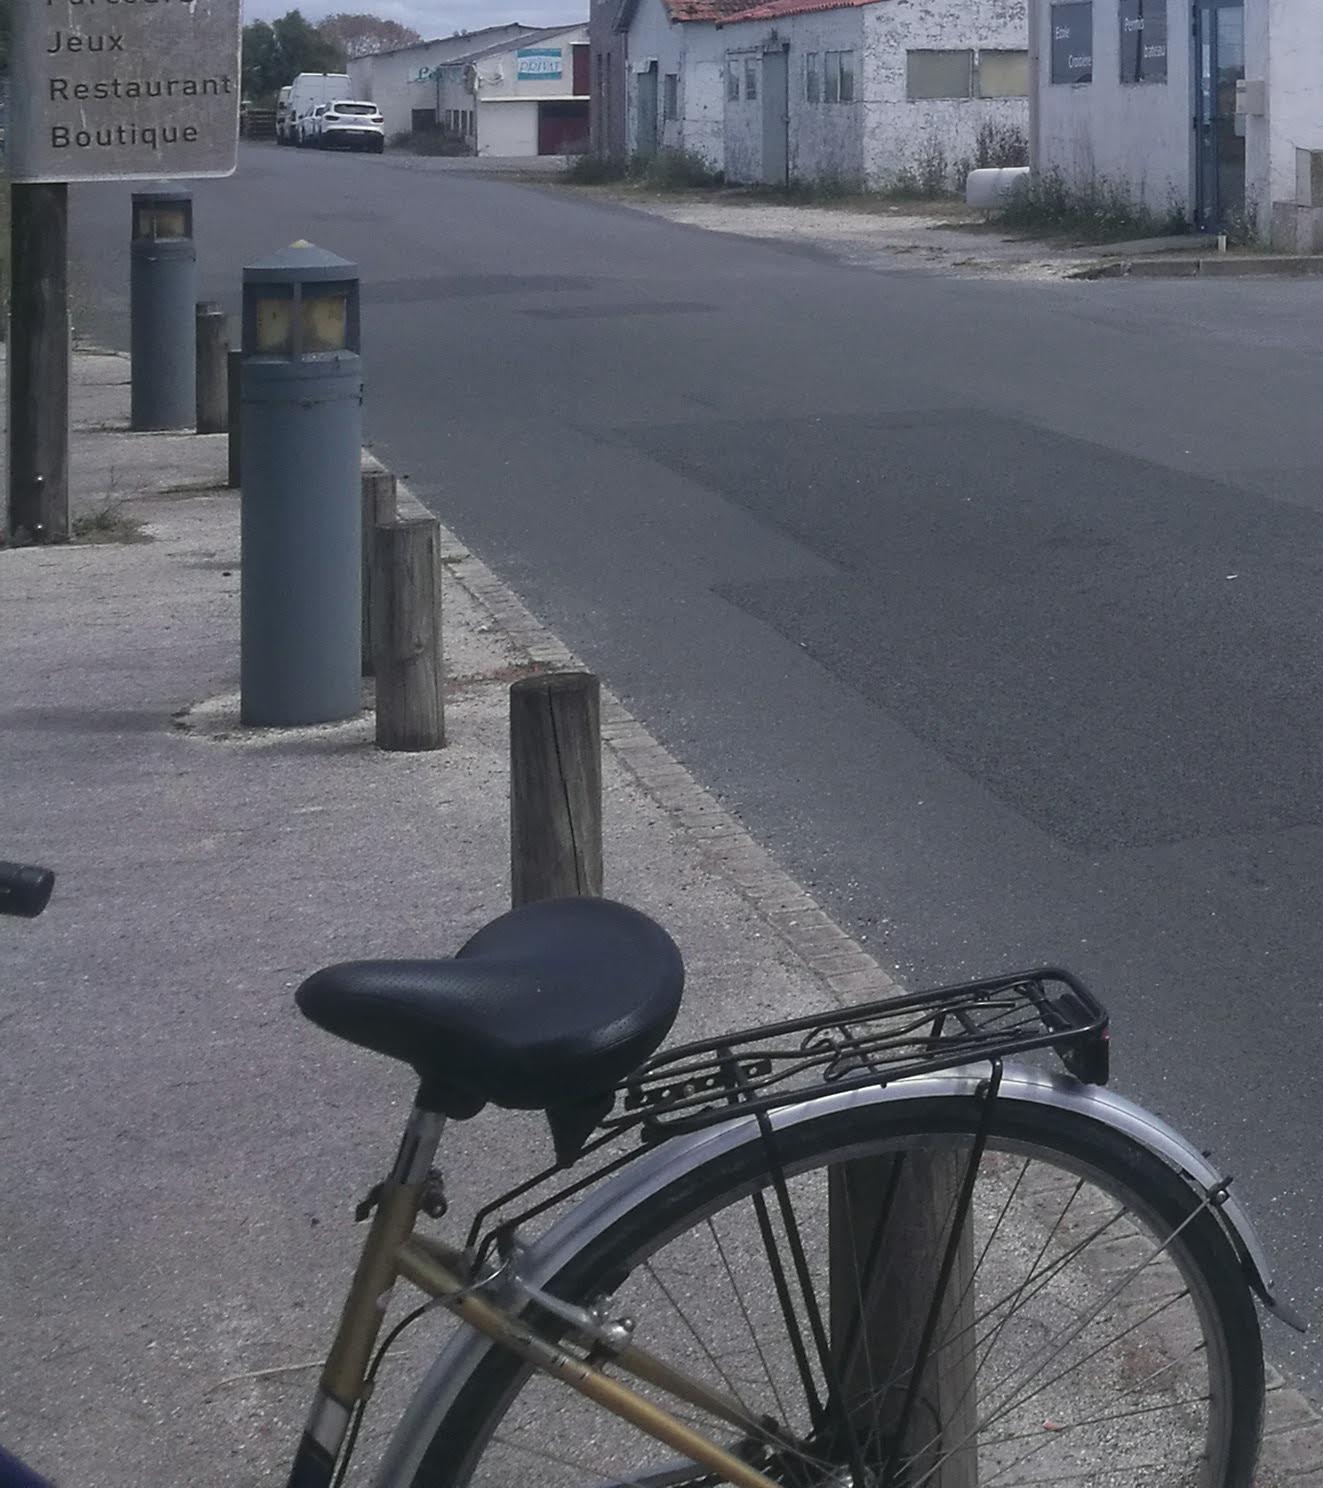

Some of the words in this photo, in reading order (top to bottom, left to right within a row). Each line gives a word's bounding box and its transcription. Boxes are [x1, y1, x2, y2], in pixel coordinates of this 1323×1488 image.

[47, 30, 124, 54] Jeux
[50, 74, 234, 101] Restaurant
[51, 123, 199, 151] Boutique
